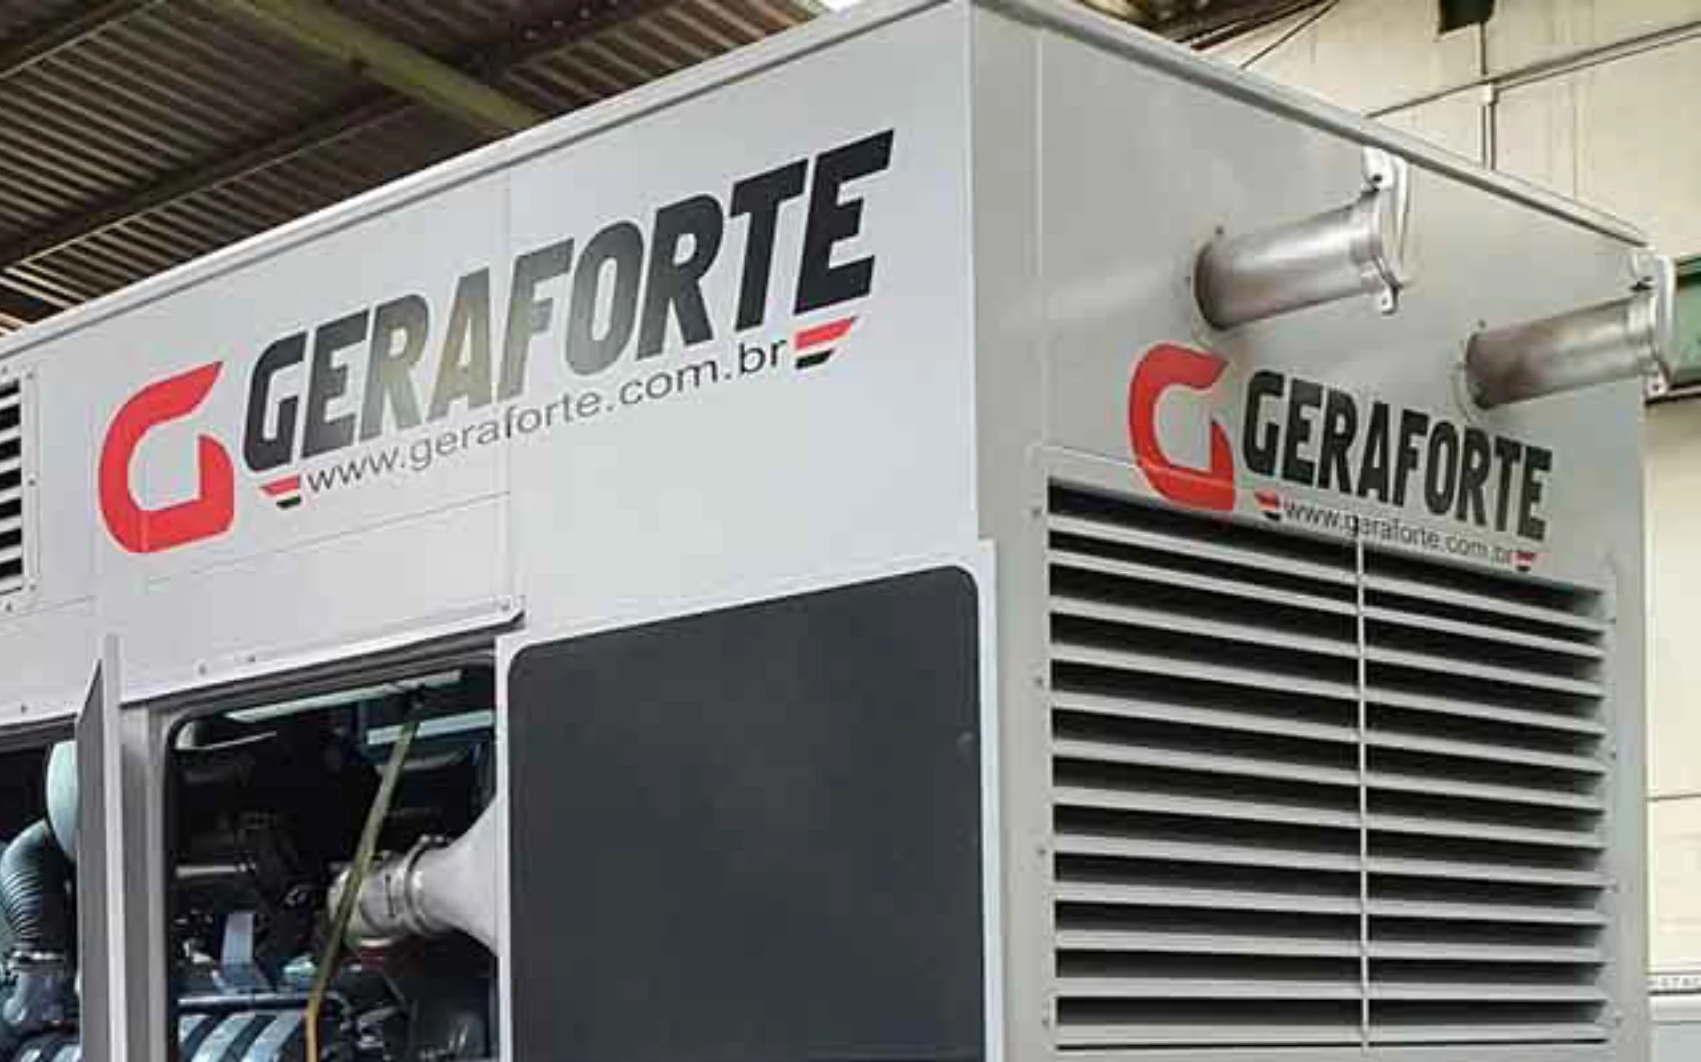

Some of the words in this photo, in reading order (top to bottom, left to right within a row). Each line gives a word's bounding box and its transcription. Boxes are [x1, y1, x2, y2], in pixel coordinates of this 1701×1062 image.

[243, 128, 895, 472] GERAFORTE
[307, 338, 788, 493] www.geraforte.com.br
[1242, 369, 1553, 541] GERAFORTE
